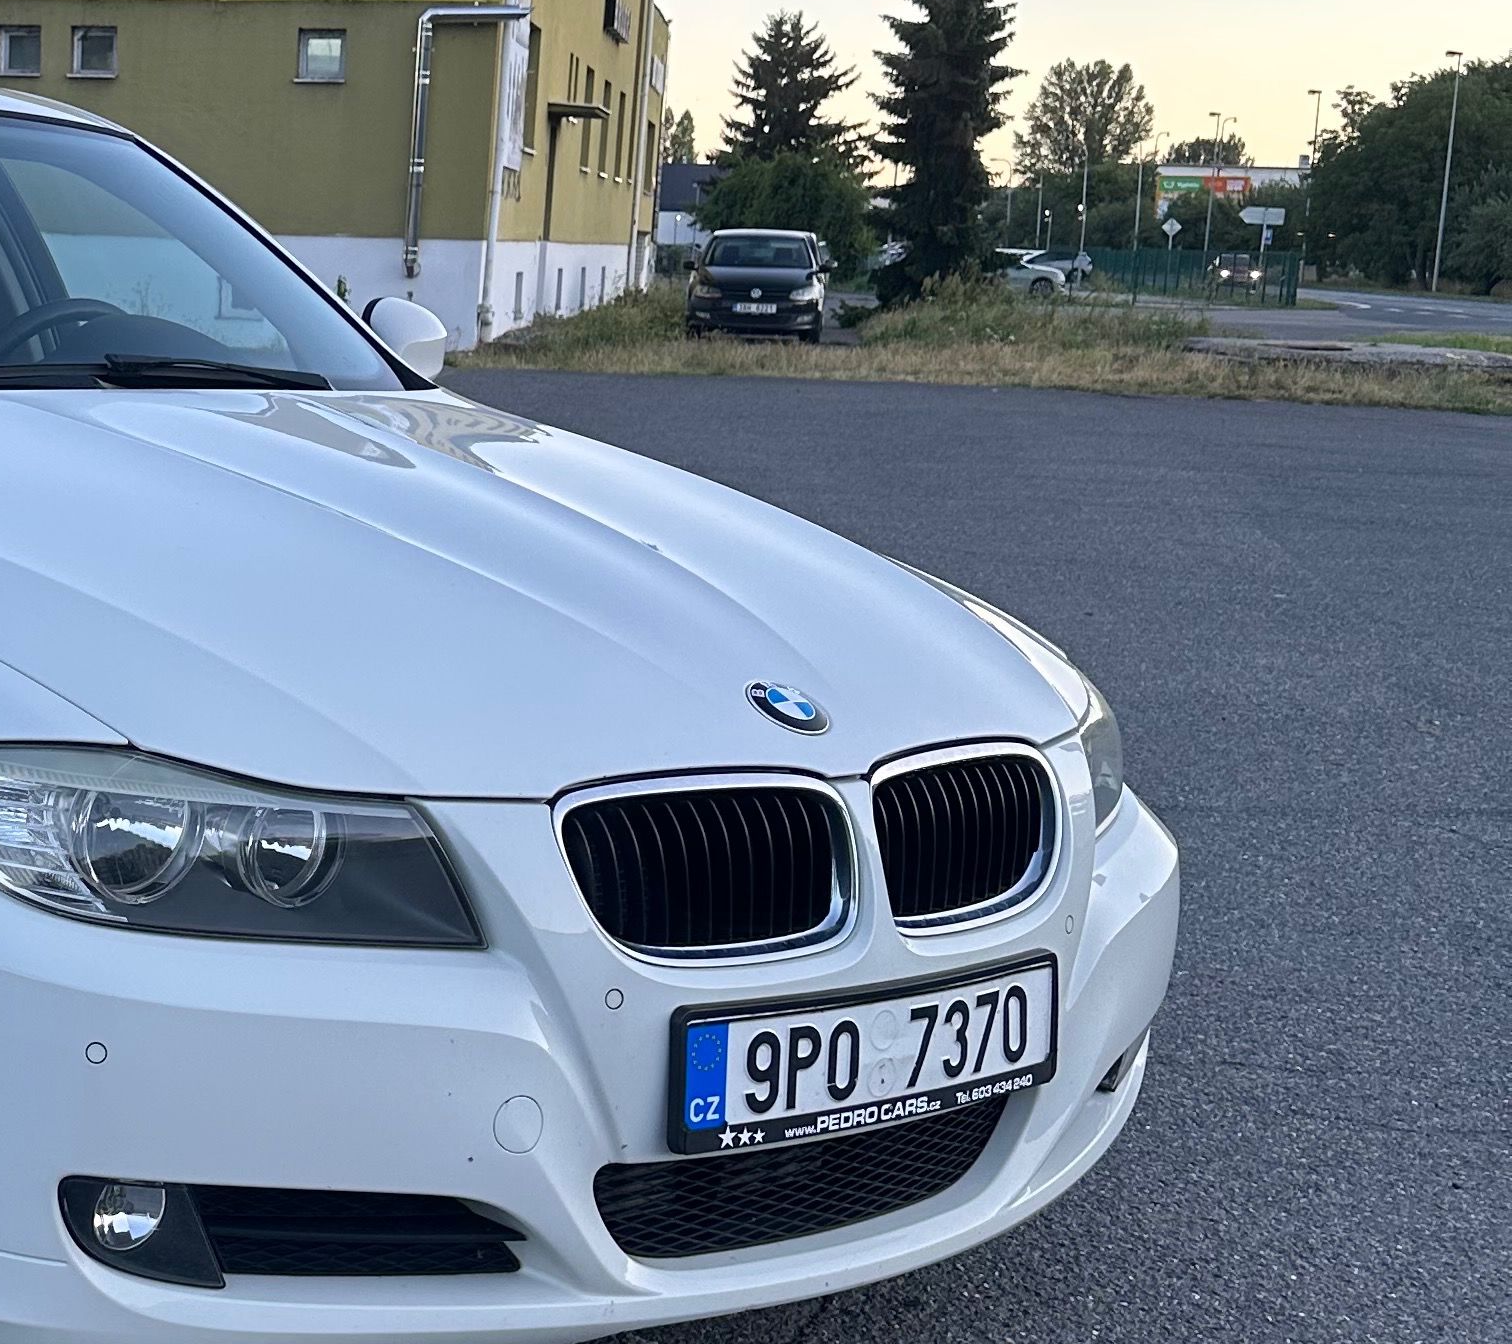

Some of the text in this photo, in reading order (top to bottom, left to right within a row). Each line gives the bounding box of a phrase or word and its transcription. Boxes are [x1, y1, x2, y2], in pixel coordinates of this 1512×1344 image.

[744, 984, 1027, 1114] 9P0 7370
[689, 1096, 720, 1123] CZ
